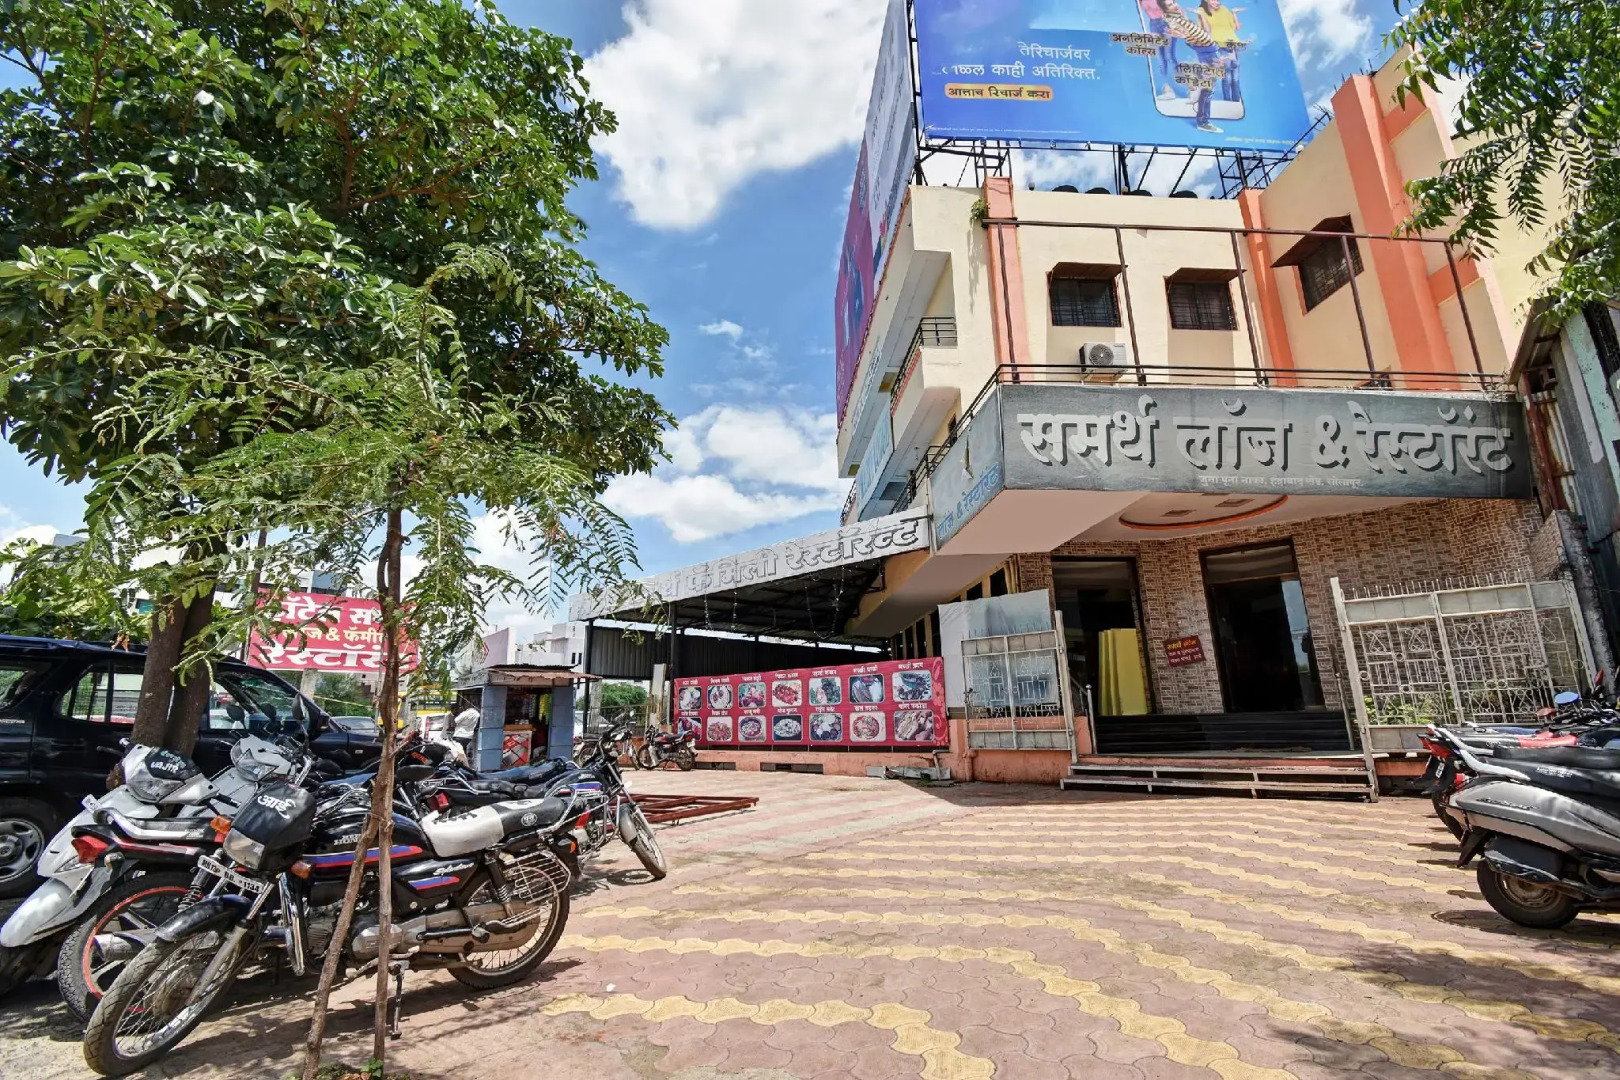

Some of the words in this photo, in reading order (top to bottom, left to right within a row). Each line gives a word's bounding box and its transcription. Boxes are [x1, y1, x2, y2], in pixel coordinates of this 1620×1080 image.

[991, 60, 1026, 78] काही
[987, 85, 1024, 98] रिचार्ज
[1026, 89, 1051, 99] करा
[1016, 393, 1161, 469] समर्थ
[1172, 397, 1294, 471] लॉज
[1312, 414, 1351, 469] &
[1346, 400, 1516, 476] रेस्टॉरंट
[325, 627, 341, 642] &
